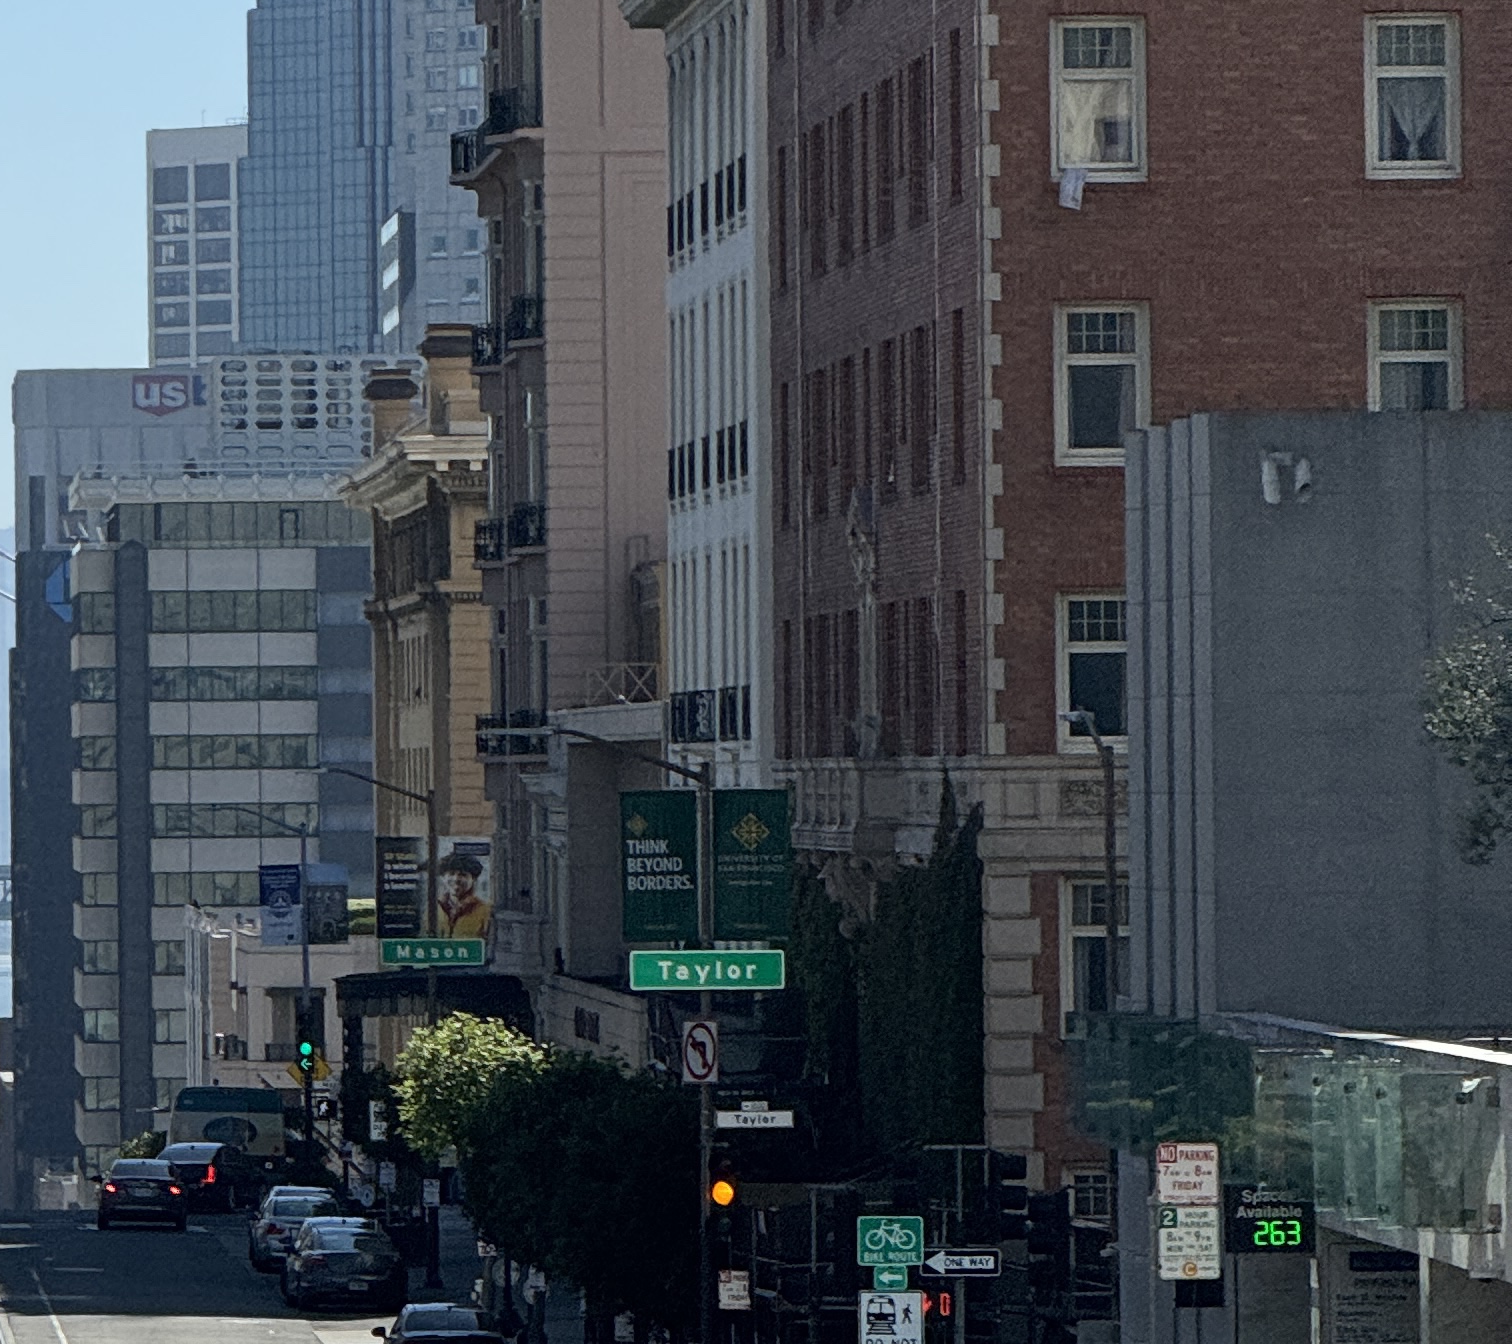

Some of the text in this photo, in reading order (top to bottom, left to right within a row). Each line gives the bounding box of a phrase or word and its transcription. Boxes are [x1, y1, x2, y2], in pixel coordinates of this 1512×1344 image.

[626, 839, 669, 855] THINK
[627, 857, 683, 873] BEYOND
[627, 875, 694, 891] BORDERS.
[396, 945, 468, 959] Mason
[657, 960, 757, 985] Taylor
[734, 1114, 776, 1126] Taylor
[1160, 1147, 1215, 1162] NO PARKING
[1172, 1181, 1204, 1191] FRIDAY
[1162, 1210, 1175, 1226] 2
[1236, 1205, 1303, 1219] Available
[1253, 1220, 1302, 1246] 263
[863, 1251, 918, 1262] BIKE ROUTE
[943, 1257, 991, 1267] ONE WAY
